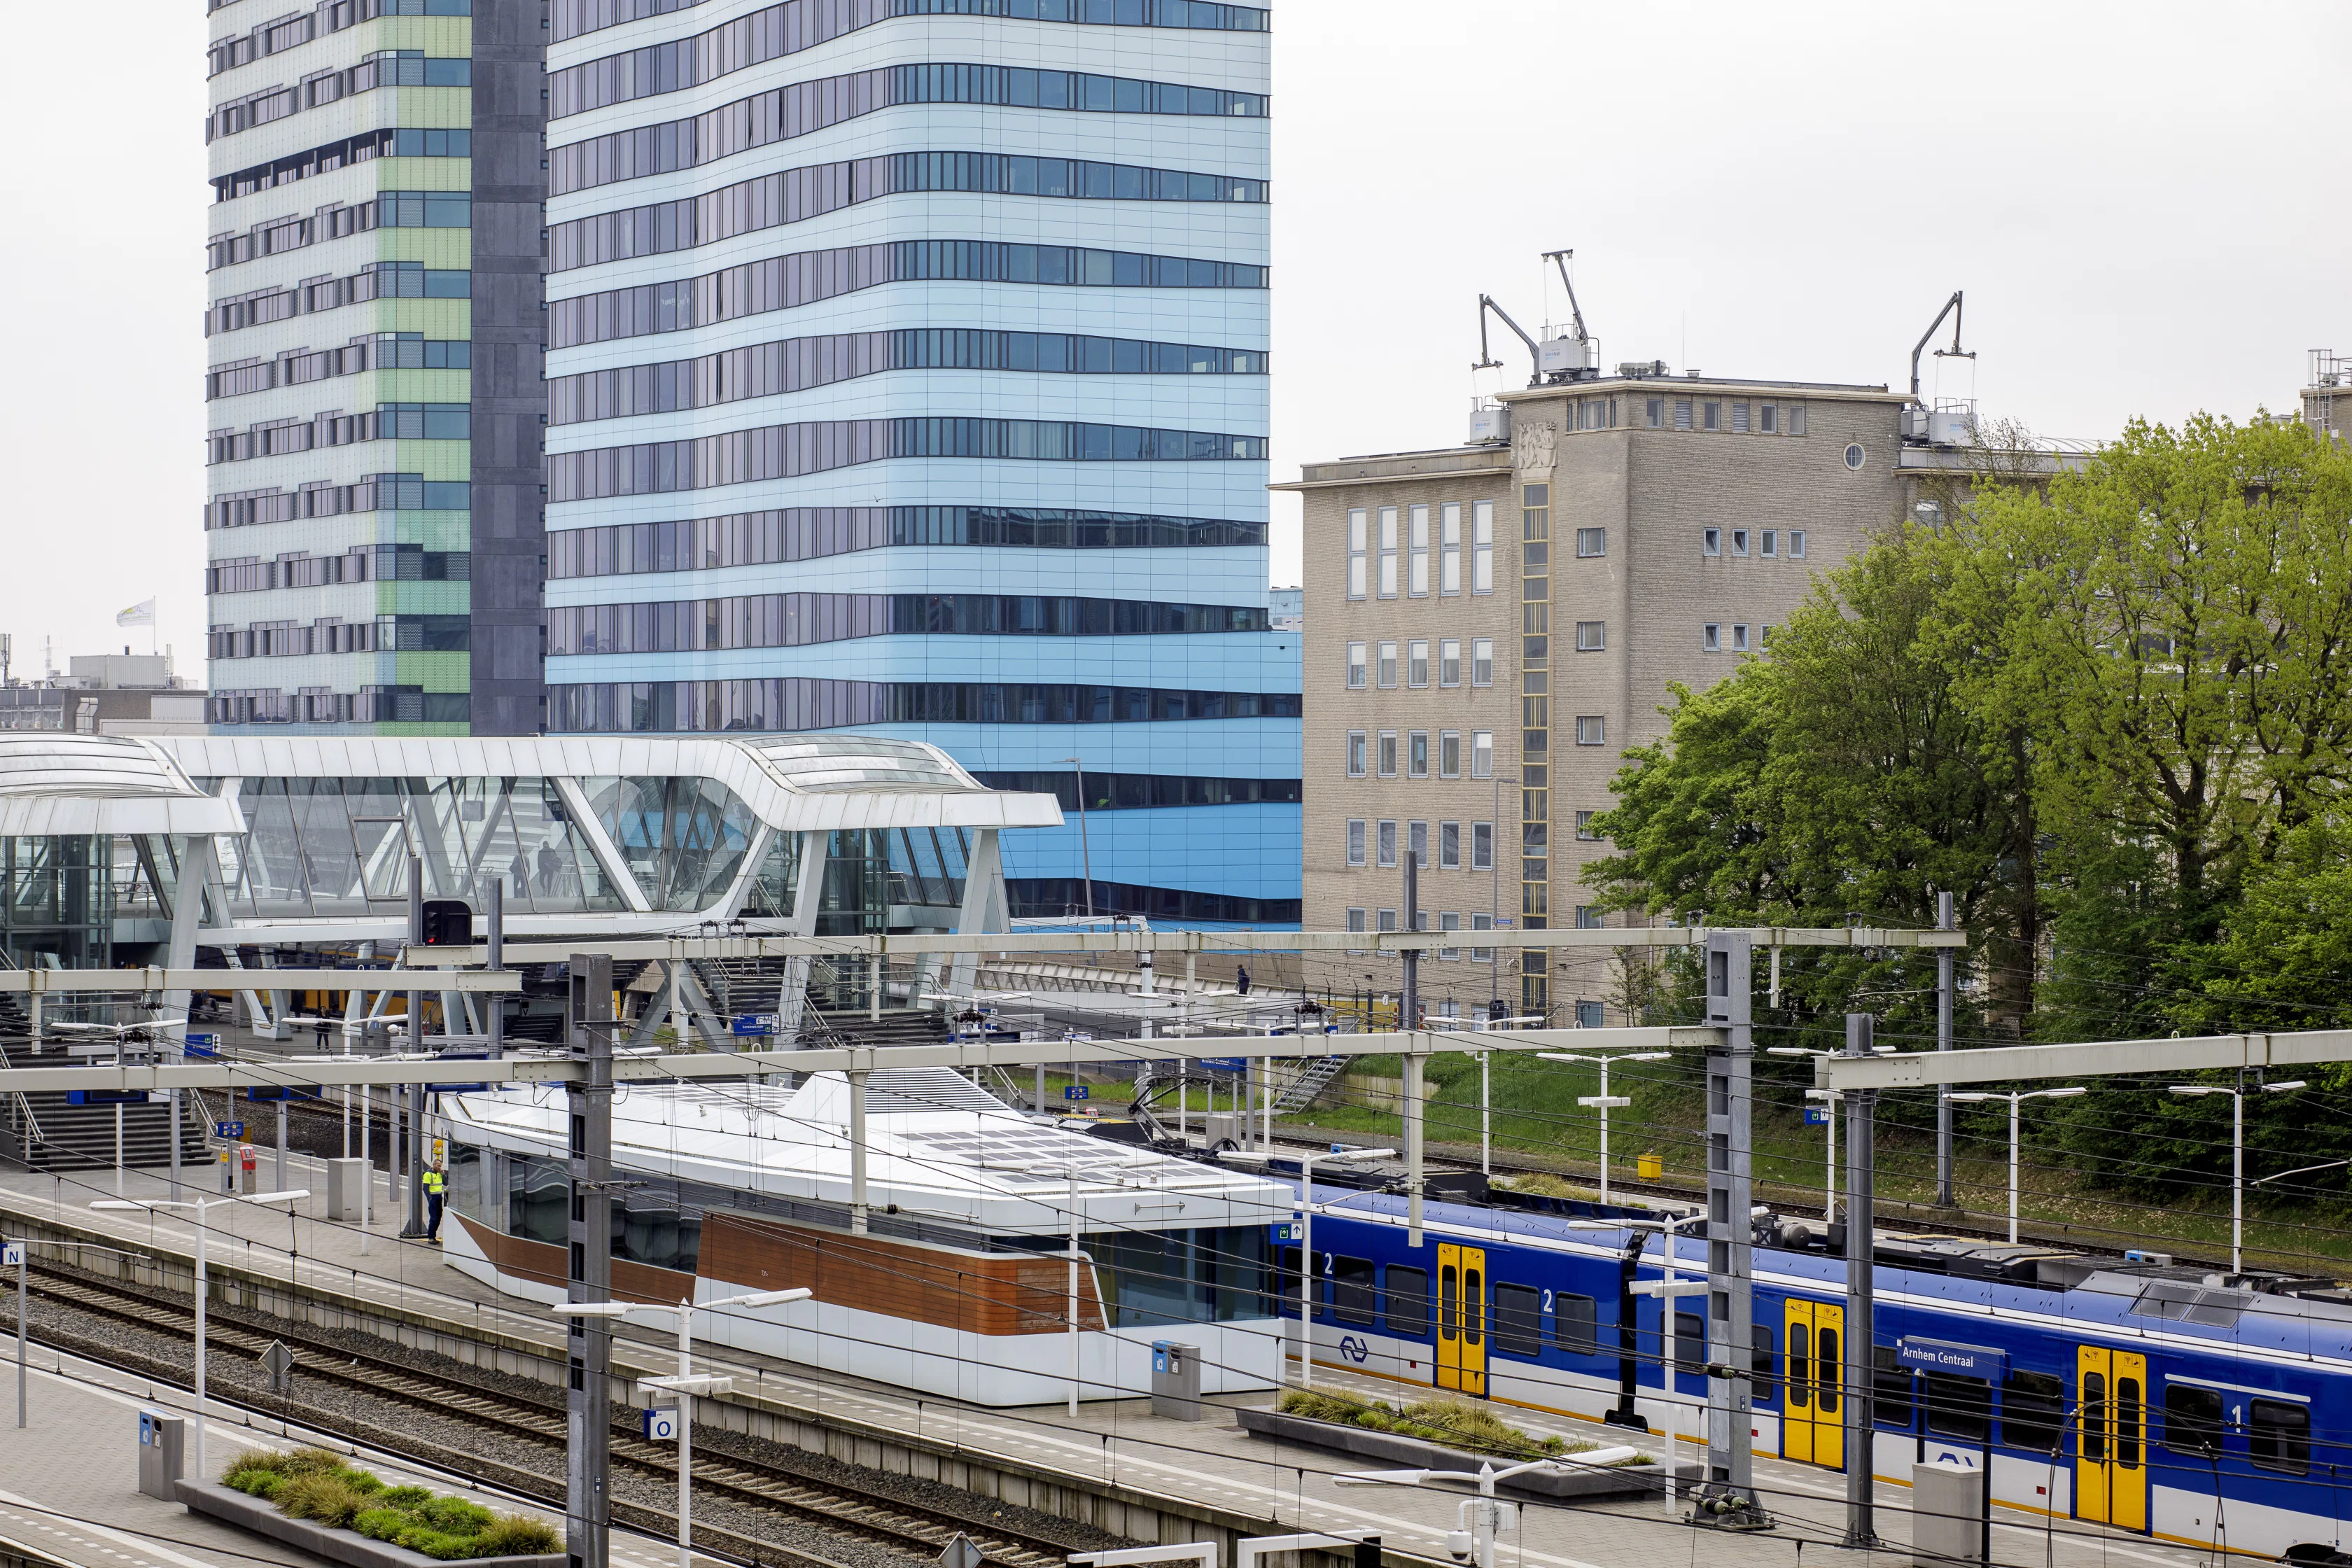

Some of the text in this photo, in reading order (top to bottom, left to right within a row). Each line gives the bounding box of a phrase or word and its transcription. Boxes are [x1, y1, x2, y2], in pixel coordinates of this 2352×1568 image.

[9, 1251, 18, 1263] N
[1325, 1252, 1333, 1275] 2
[1544, 1289, 1553, 1313] 2
[1903, 1346, 1973, 1368] Arnhem Centraal
[657, 1420, 671, 1437] O
[2232, 1405, 2241, 1434] 1
